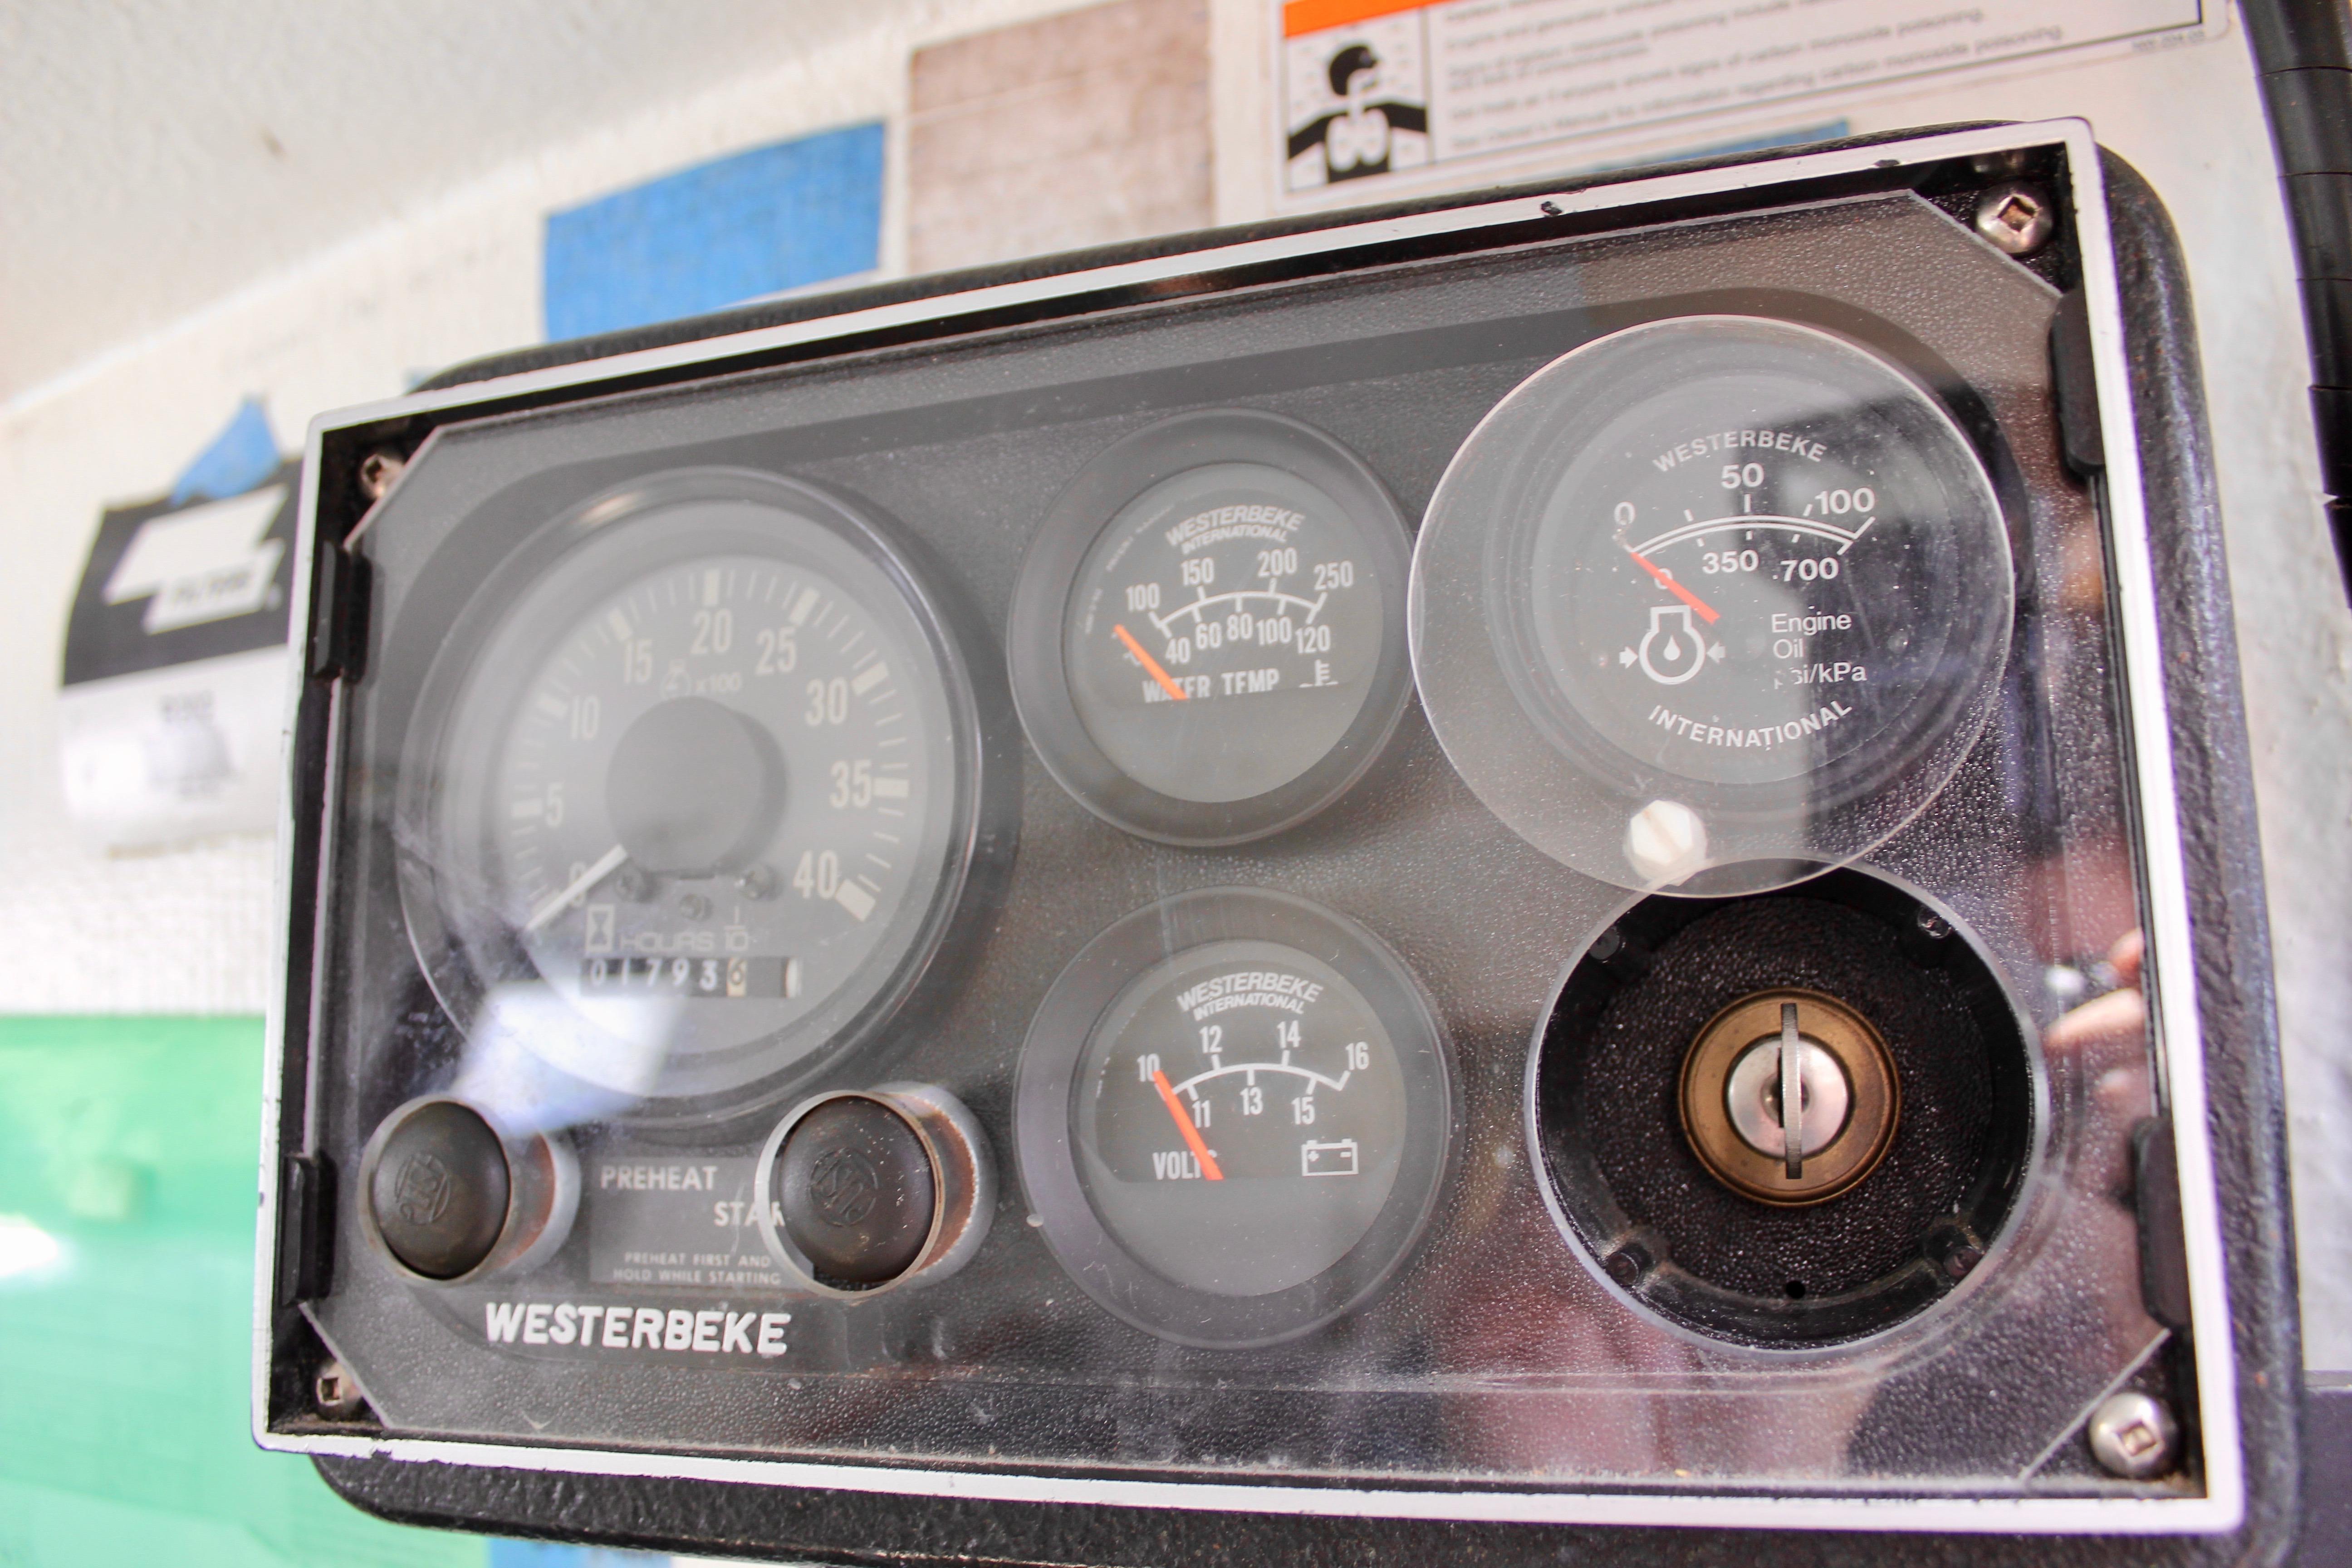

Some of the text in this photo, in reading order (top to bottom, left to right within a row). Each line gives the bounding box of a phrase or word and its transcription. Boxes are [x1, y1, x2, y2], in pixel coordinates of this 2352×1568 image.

[1652, 431, 1827, 472] WESTERBEKE
[1720, 463, 1764, 489] 50
[1613, 501, 1635, 525] 0
[1815, 487, 1875, 515] 100
[1165, 505, 1305, 546] WESTERBEKE
[1181, 524, 1288, 554] INTERNATIONAL
[1126, 548, 1353, 611] 100 150 200 250
[1702, 549, 1759, 574] 350
[1781, 557, 1839, 582] 700
[691, 608, 733, 654] 20
[1165, 637, 1191, 664] 40
[1196, 622, 1222, 649] 60
[1227, 613, 1253, 641] 80
[1257, 617, 1292, 646] 100
[1295, 625, 1330, 654] 120
[1771, 612, 1852, 636] Engine
[623, 639, 652, 683] 15
[755, 627, 797, 676] 25
[1773, 638, 1804, 659] Oil
[1222, 668, 1280, 695] TEMP
[1774, 662, 1867, 690] si/kPa
[569, 695, 600, 740] 10
[806, 677, 848, 726] 30
[1648, 700, 1852, 749] INTERNATIONAL
[546, 783, 563, 825] 5
[830, 760, 872, 808] 35
[794, 850, 838, 899] 40
[620, 931, 714, 952] HOURS
[1176, 972, 1323, 1013] WESTERBEKE
[1193, 992, 1305, 1022] INTERNATIONAL
[1137, 1020, 1369, 1082] 10 12 14 16
[1192, 1087, 1316, 1128] 11 13 15
[601, 1165, 718, 1191] PREHEAT
[1152, 1150, 1218, 1181] VOLT
[612, 1268, 781, 1286] HOLD WHILE STARTING
[624, 1252, 771, 1269] PREHEAT FIRST AND
[485, 1302, 792, 1357] WESTERBEKE
